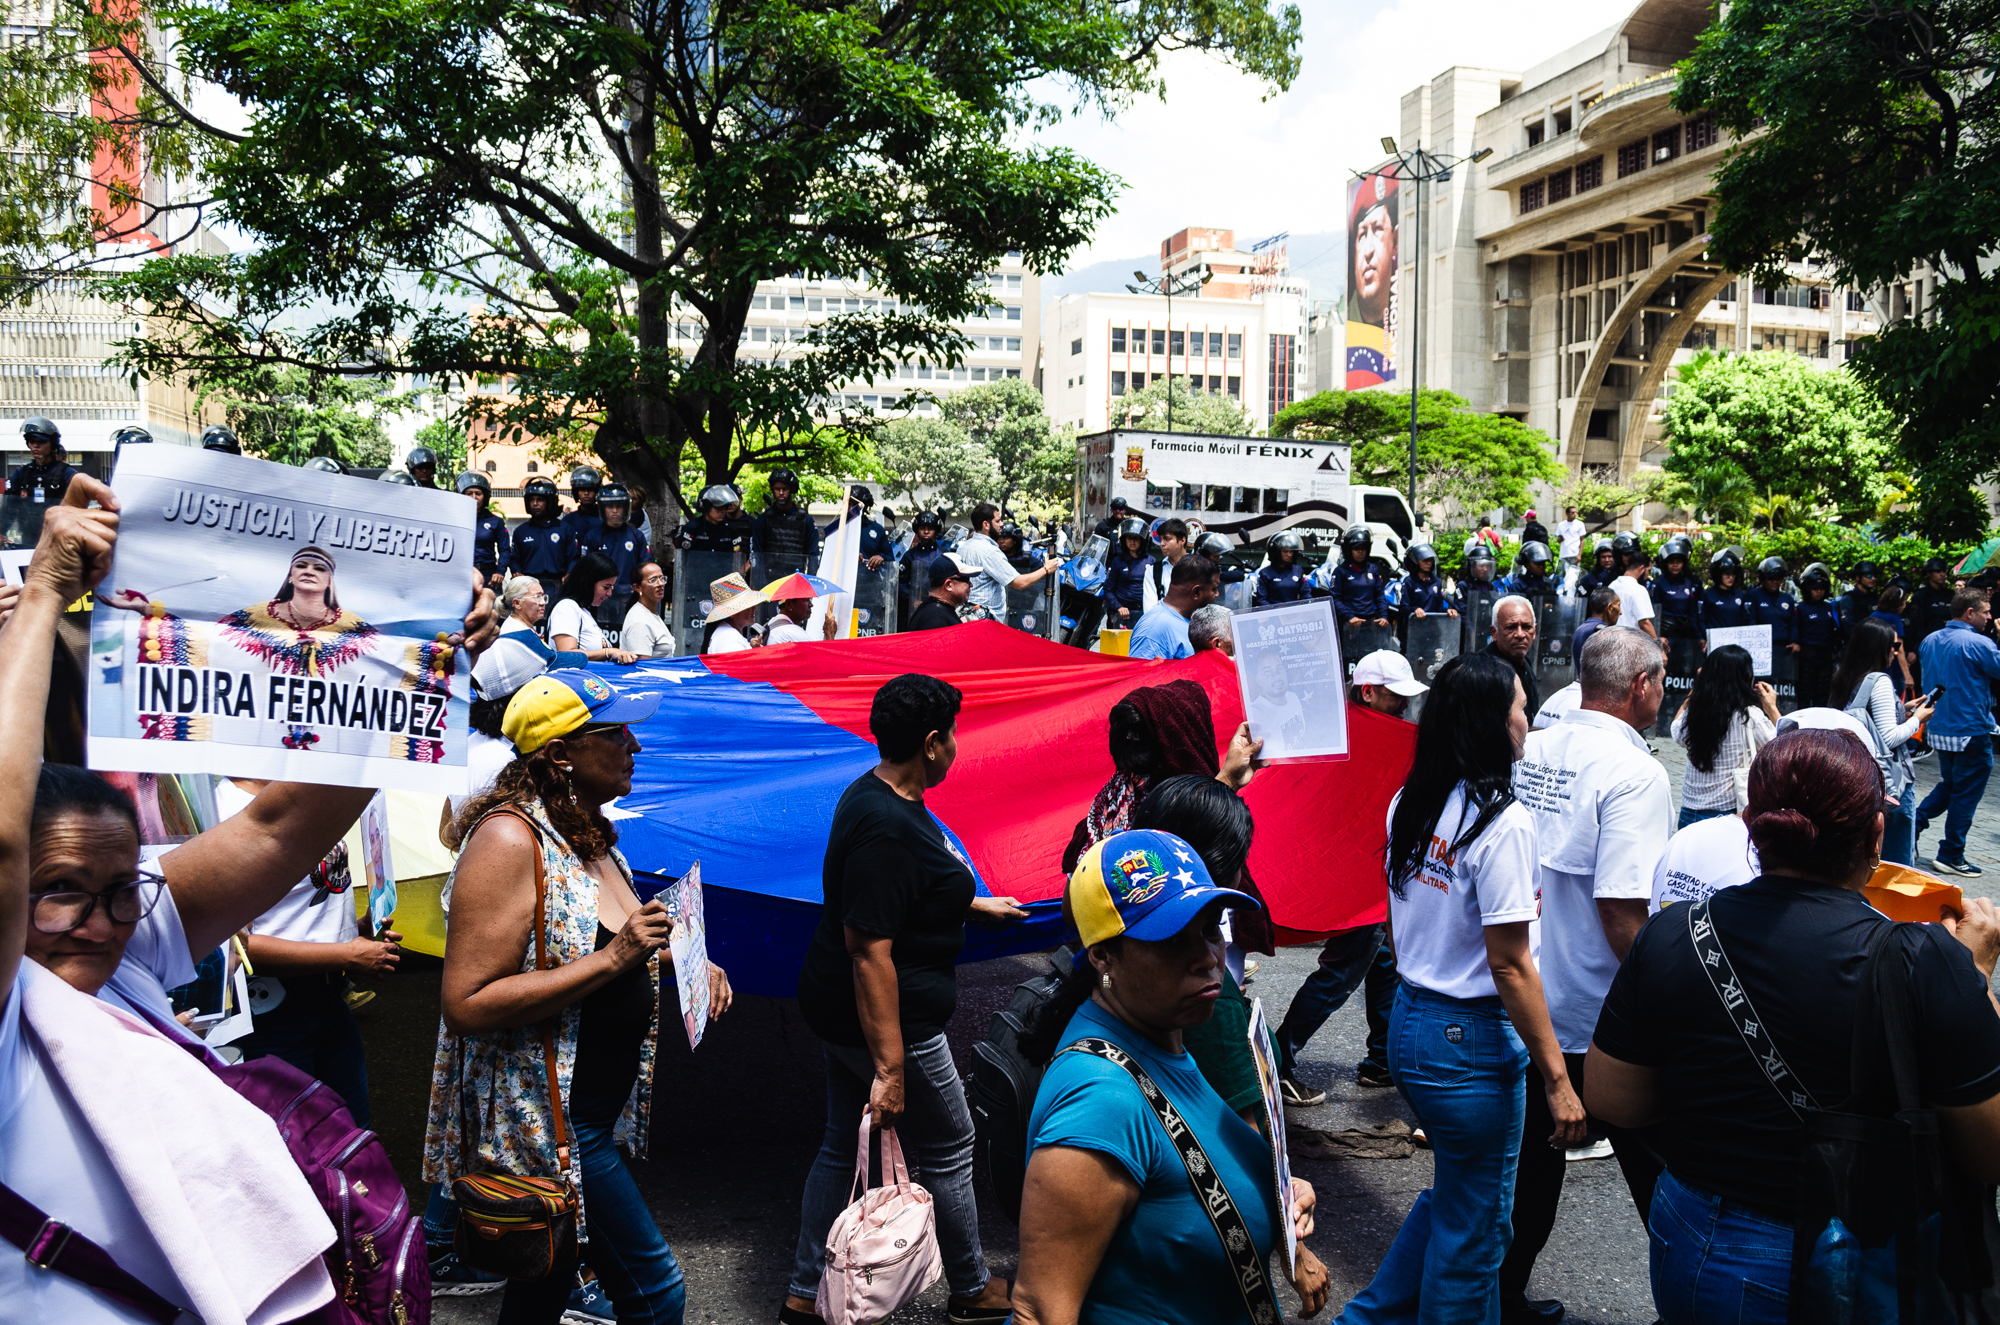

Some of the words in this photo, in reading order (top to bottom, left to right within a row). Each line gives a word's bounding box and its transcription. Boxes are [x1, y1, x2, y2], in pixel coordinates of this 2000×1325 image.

[1389, 269, 1398, 370] NACIONAL
[1151, 439, 1203, 453] Farmacia
[1208, 442, 1240, 455] Móvil
[1246, 443, 1314, 458] FÉNIX
[162, 488, 296, 541] JUSTICIA
[307, 510, 325, 544] Y
[329, 514, 455, 563] LIBERTAD
[691, 619, 707, 629] CP
[857, 628, 877, 637] PNB
[1542, 656, 1566, 666] CPNB
[1665, 676, 1694, 690] POLIC
[1773, 683, 1796, 697] LICÍA
[138, 665, 256, 718] INDIRA
[268, 675, 445, 738] FERNÁNDEZ
[1538, 763, 1557, 775] López
[1527, 778, 1545, 789] General
[1667, 879, 1686, 890] CASO
[1687, 885, 1700, 896] LAS
[1701, 891, 1709, 900] TE
